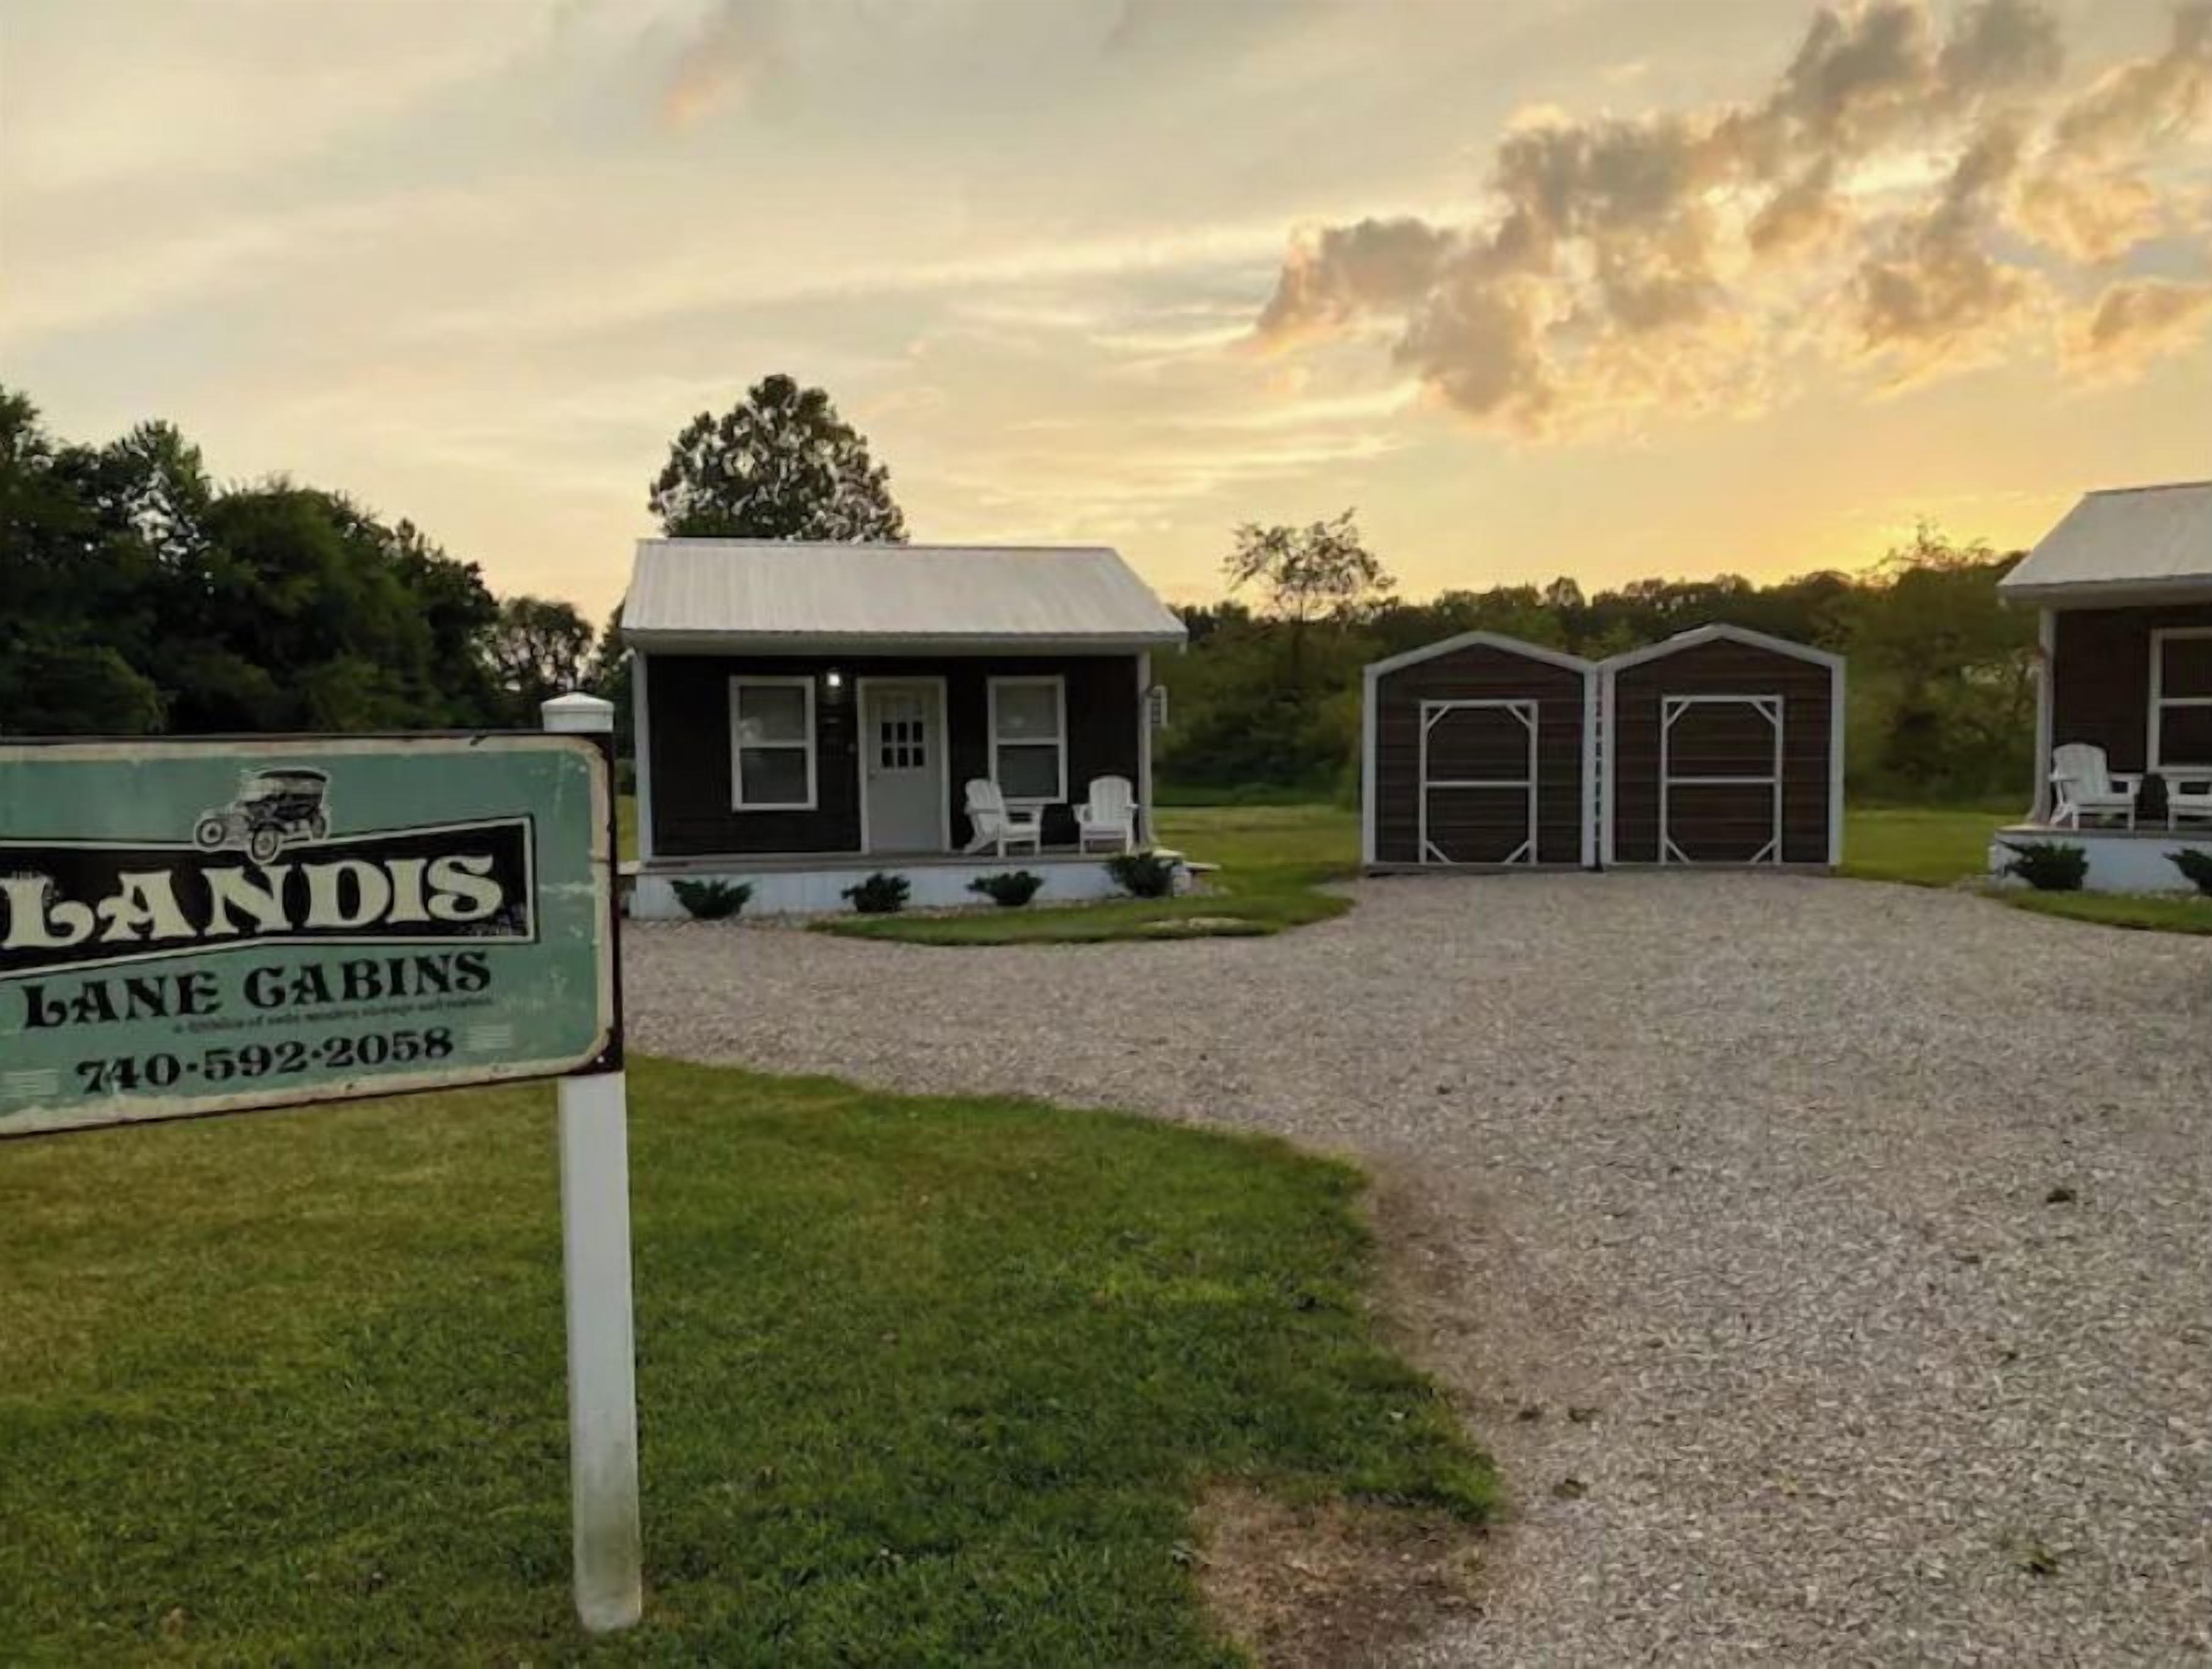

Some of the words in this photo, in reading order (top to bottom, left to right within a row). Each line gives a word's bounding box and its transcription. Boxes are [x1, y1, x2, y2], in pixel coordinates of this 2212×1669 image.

[0, 854, 503, 949] LANDIS
[21, 971, 222, 1028] LANE
[244, 952, 490, 1009] CABINS
